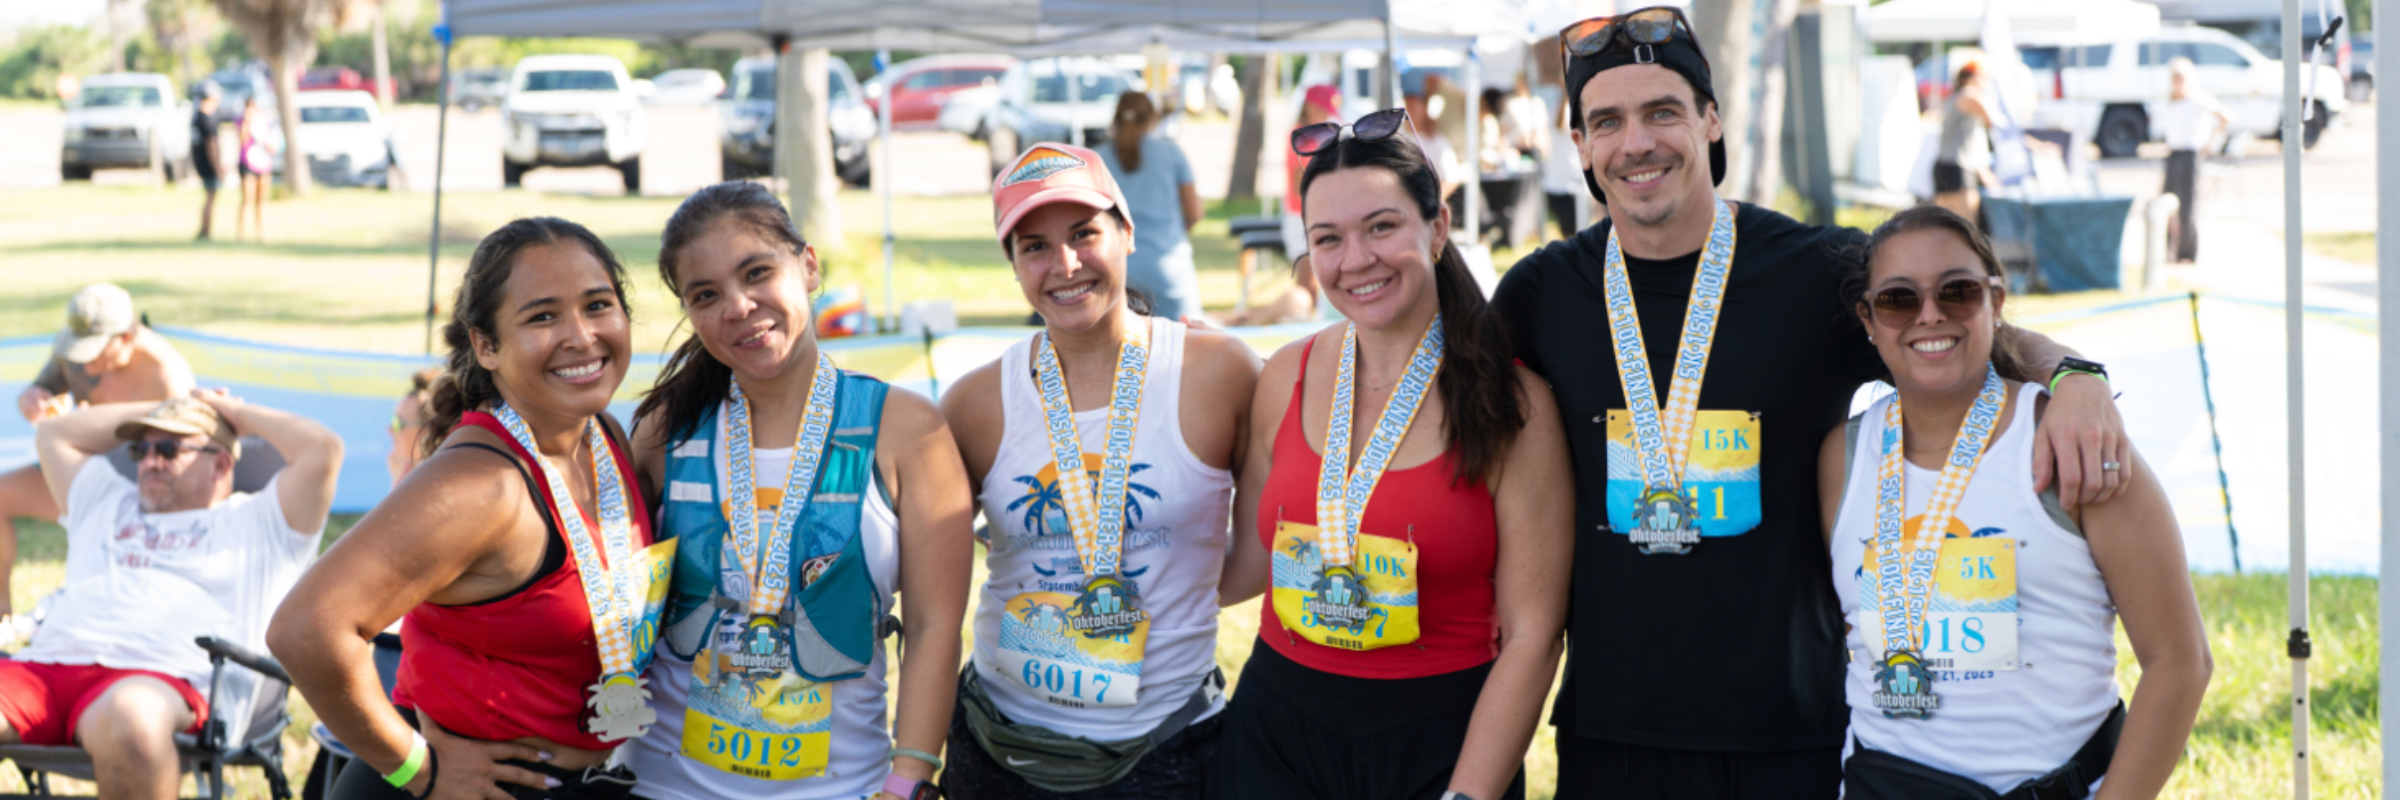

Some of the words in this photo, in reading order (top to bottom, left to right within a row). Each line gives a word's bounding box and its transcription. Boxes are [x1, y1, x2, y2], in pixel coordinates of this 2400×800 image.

[1703, 428, 1750, 450] 15K
[1629, 528, 1701, 543] Oktoberfest
[1364, 553, 1407, 578] 10K
[1961, 556, 1998, 579] 5K
[1309, 600, 1371, 619] Oktoberfest
[1073, 610, 1142, 632] Oktoberfest
[731, 652, 790, 669] Oktoberfest
[1022, 659, 1112, 703] 6017
[1871, 692, 1940, 709] Oktoberfest
[707, 722, 803, 768] 5012
